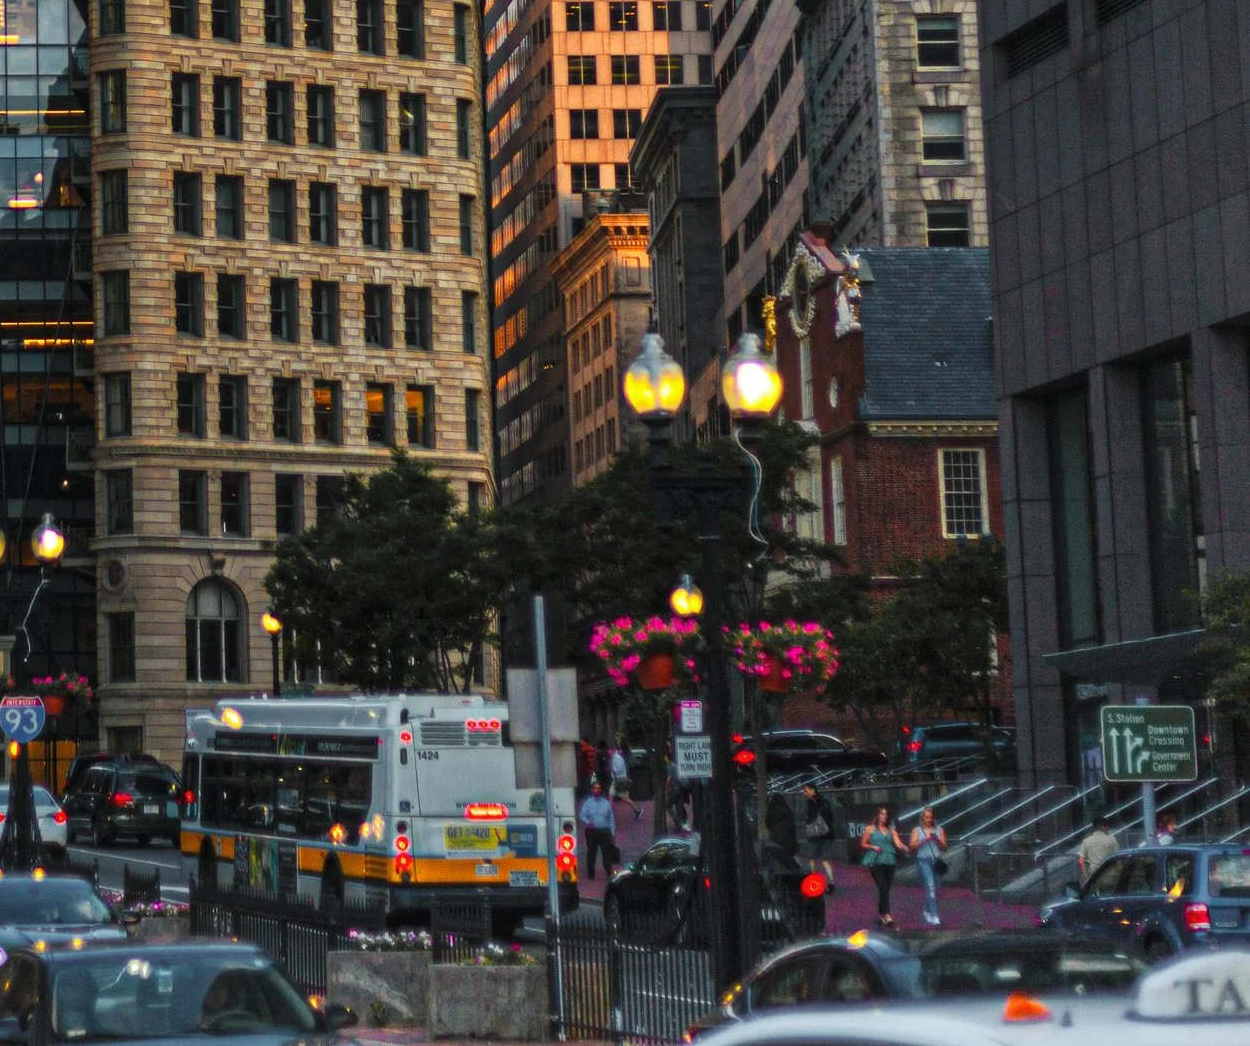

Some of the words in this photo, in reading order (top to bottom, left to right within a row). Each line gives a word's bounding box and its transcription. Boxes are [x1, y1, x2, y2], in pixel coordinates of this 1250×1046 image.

[5, 708, 37, 734] 93
[1107, 714, 1116, 723] S.
[1116, 714, 1145, 723] Station
[1147, 725, 1189, 734] Downtown
[678, 742, 696, 750] RIGHT
[1149, 736, 1185, 746] Crossing
[417, 751, 439, 760] 1424
[683, 752, 709, 762] MUST
[1151, 751, 1191, 761] Government
[680, 763, 696, 771] TURN
[1152, 762, 1178, 772] Center
[447, 827, 463, 839] GET
